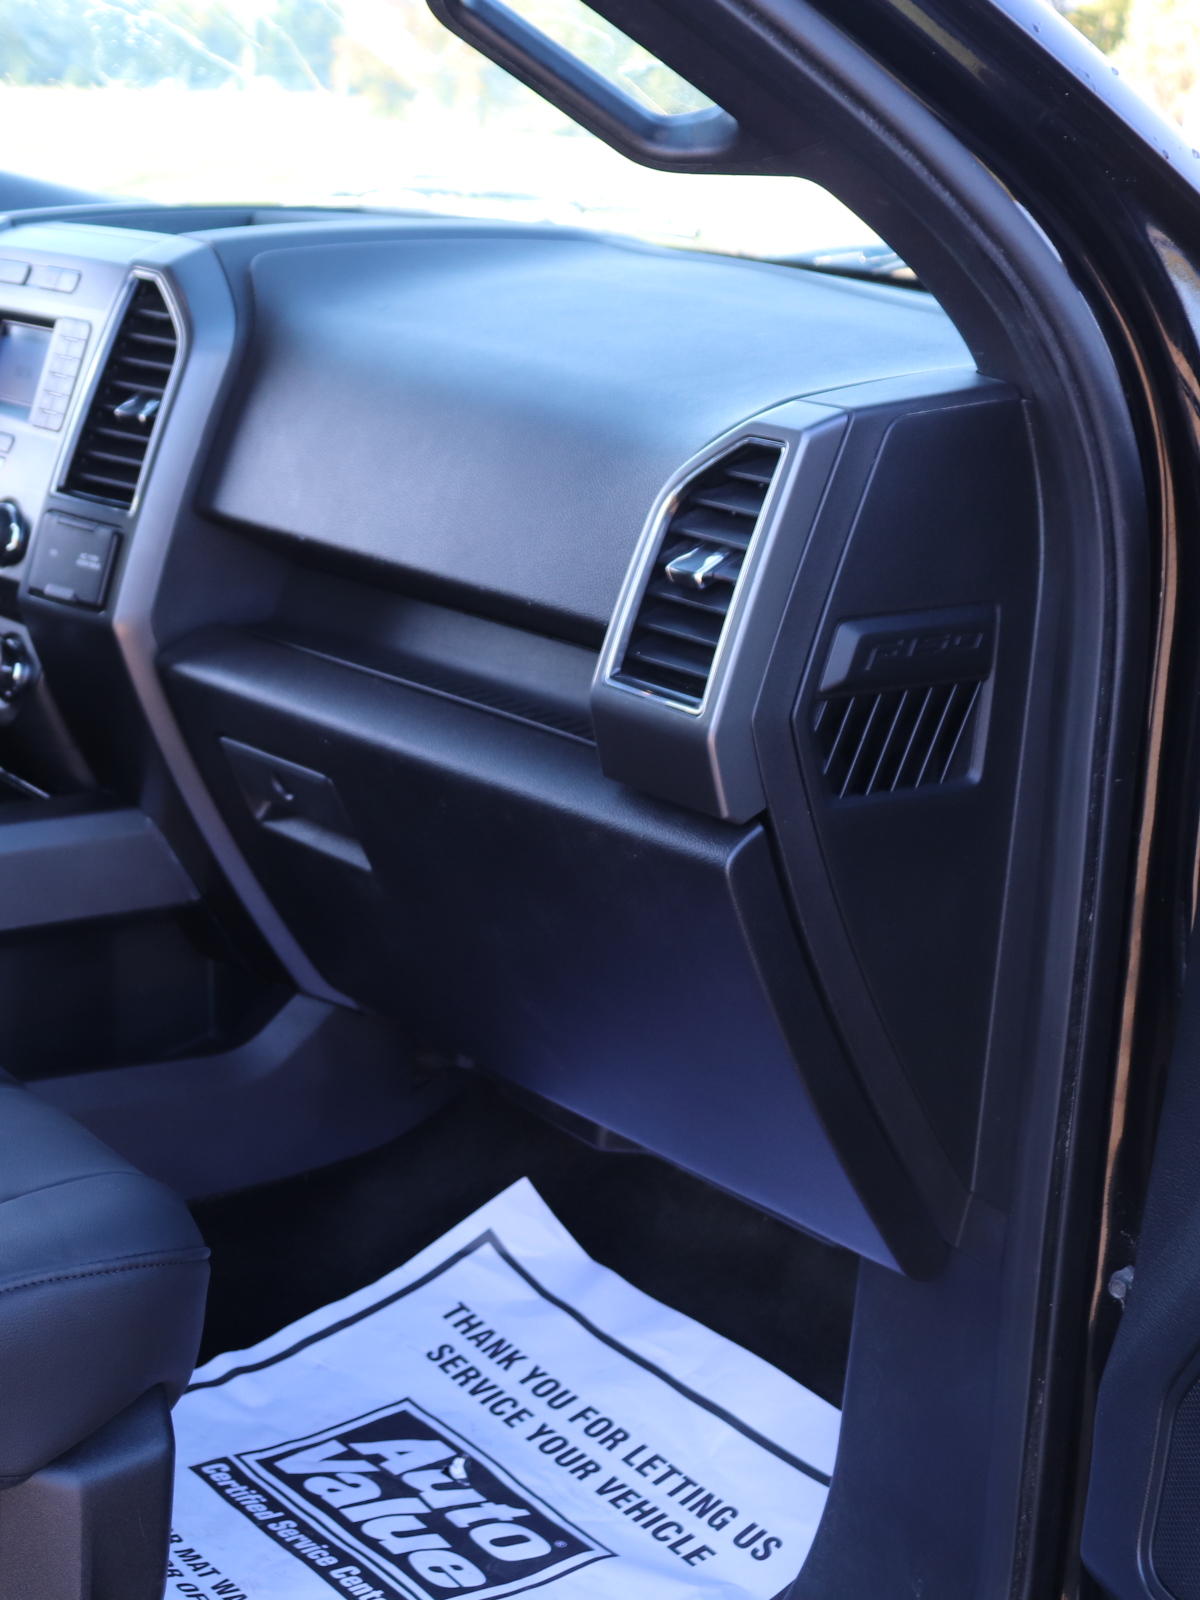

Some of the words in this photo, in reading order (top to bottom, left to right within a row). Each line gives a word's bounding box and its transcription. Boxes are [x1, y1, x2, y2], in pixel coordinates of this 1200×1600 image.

[426, 1343, 536, 1429] SERVICE
[525, 1422, 603, 1482] YOUR
[594, 1475, 718, 1567] VEHICLE
[442, 1301, 528, 1371] THANK
[518, 1365, 579, 1410] YOU
[568, 1405, 631, 1452] FOR
[621, 1443, 740, 1532] LETTING
[732, 1521, 783, 1561] US
[173, 1547, 222, 1578] MAT
[200, 1462, 285, 1521] Certified
[267, 1518, 339, 1568] Service
[273, 1439, 487, 1588] Value
[348, 1438, 552, 1562] Auto
